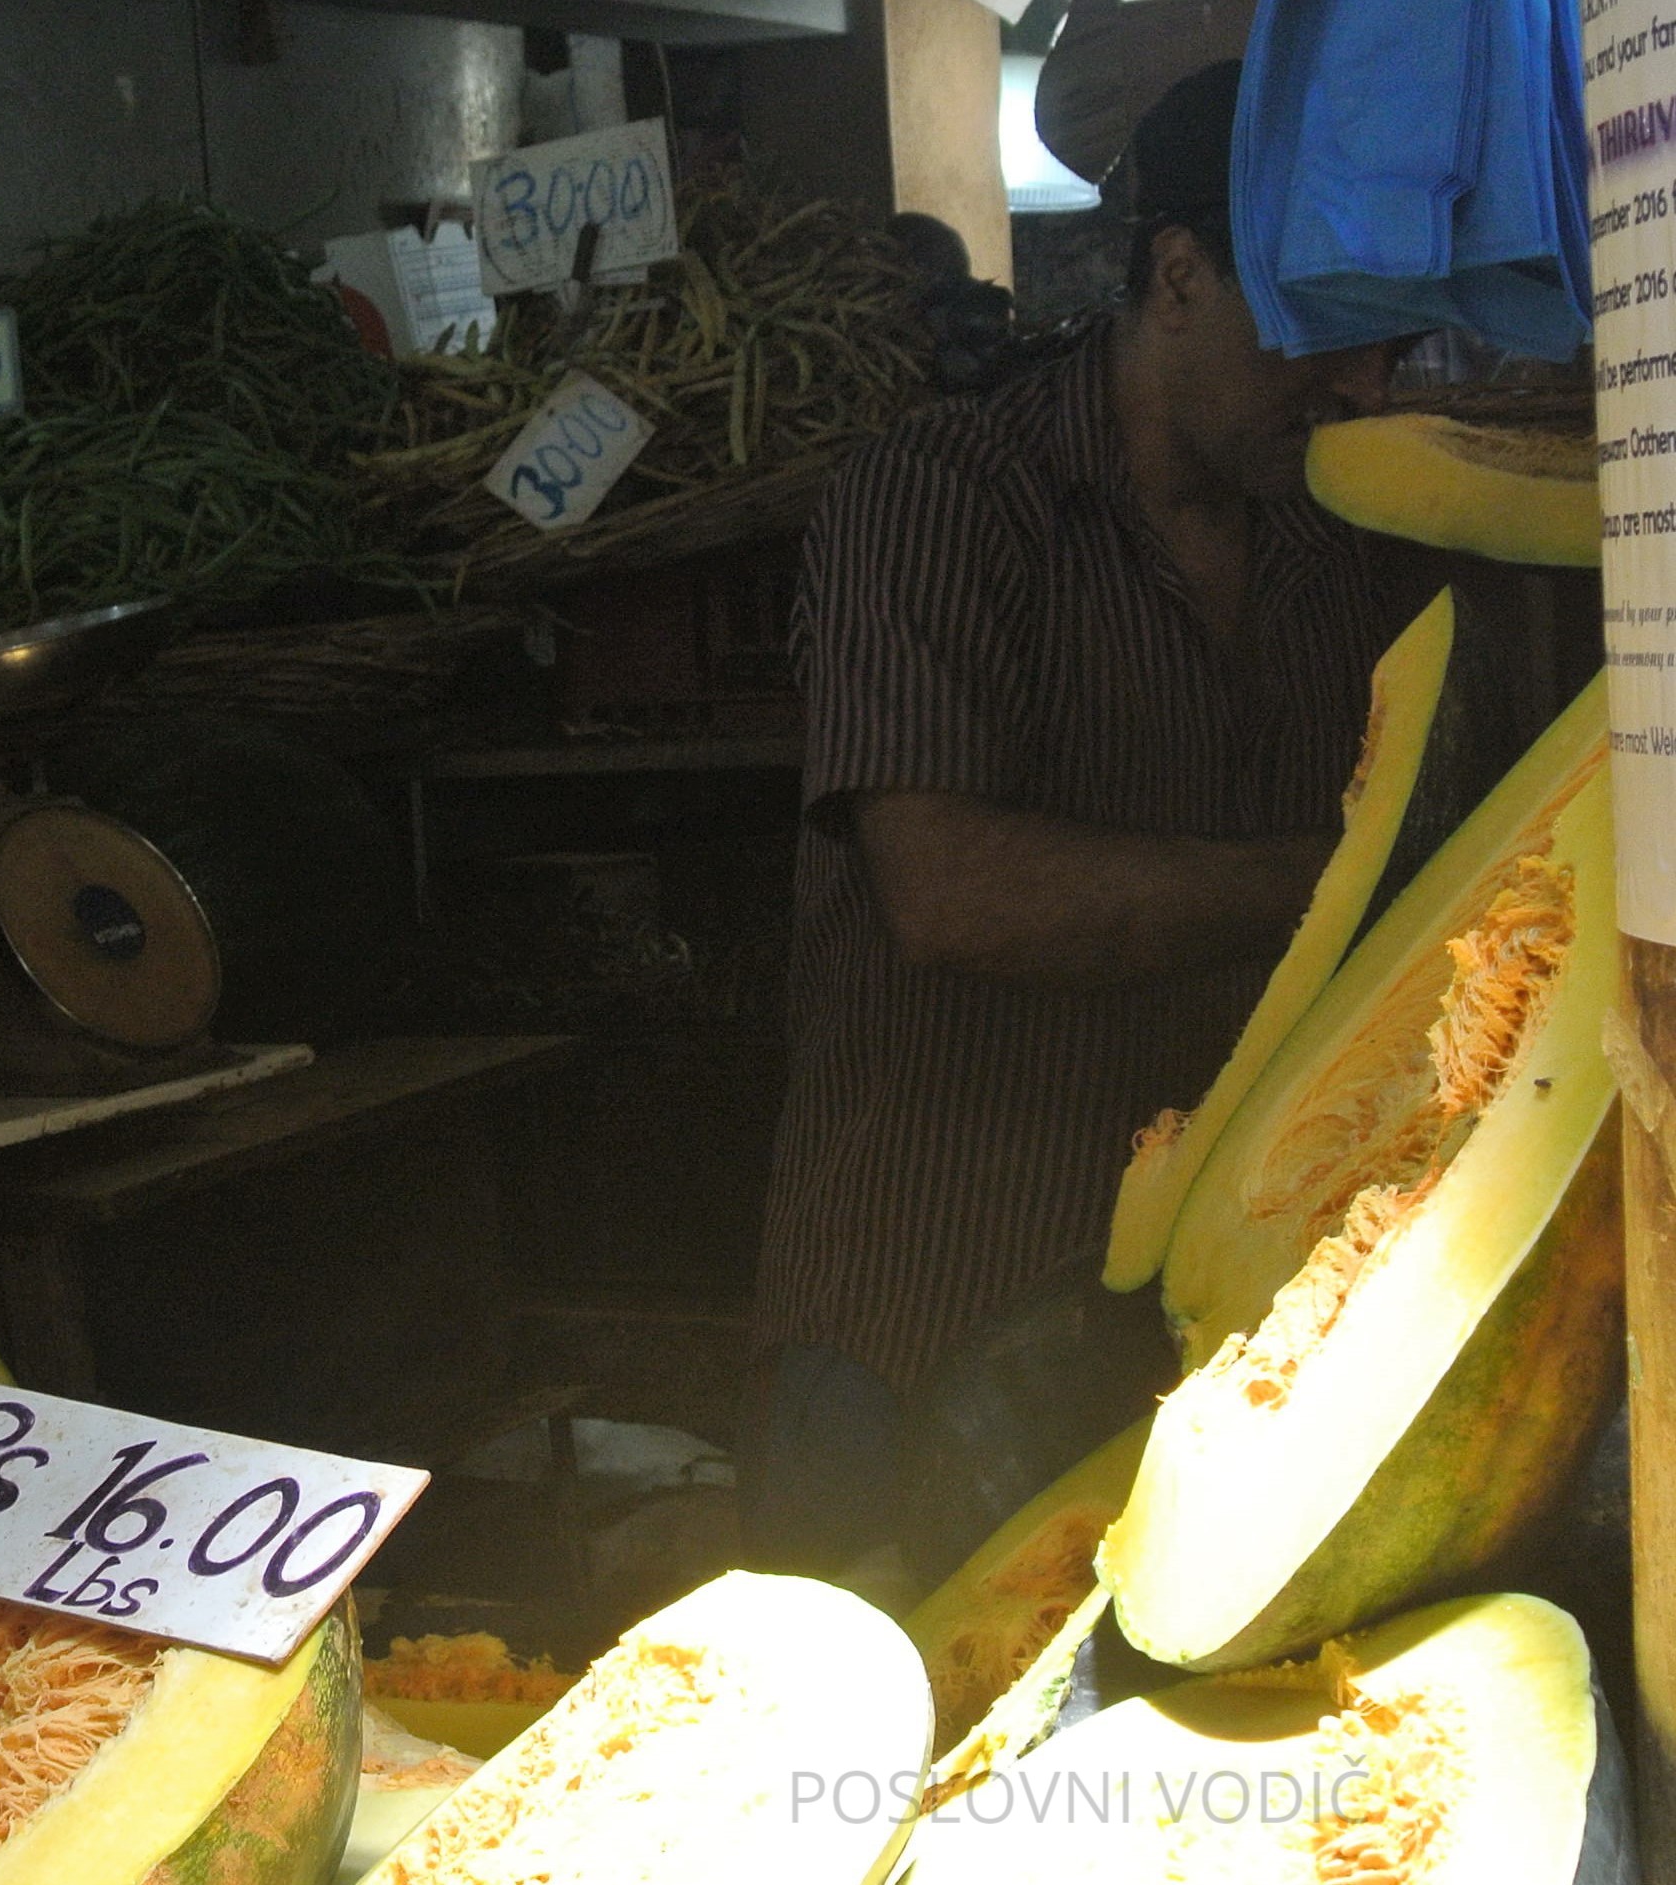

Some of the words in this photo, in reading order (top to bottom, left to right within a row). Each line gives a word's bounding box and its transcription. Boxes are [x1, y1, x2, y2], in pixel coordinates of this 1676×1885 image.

[1597, 35, 1615, 76] and
[1618, 31, 1647, 73] your
[1634, 187, 1668, 225] 2016
[1635, 269, 1668, 304] 2016
[1623, 513, 1640, 536] are
[1642, 502, 1676, 535] most
[44, 1439, 382, 1598] 16.00
[23, 1540, 160, 1618] Lbs
